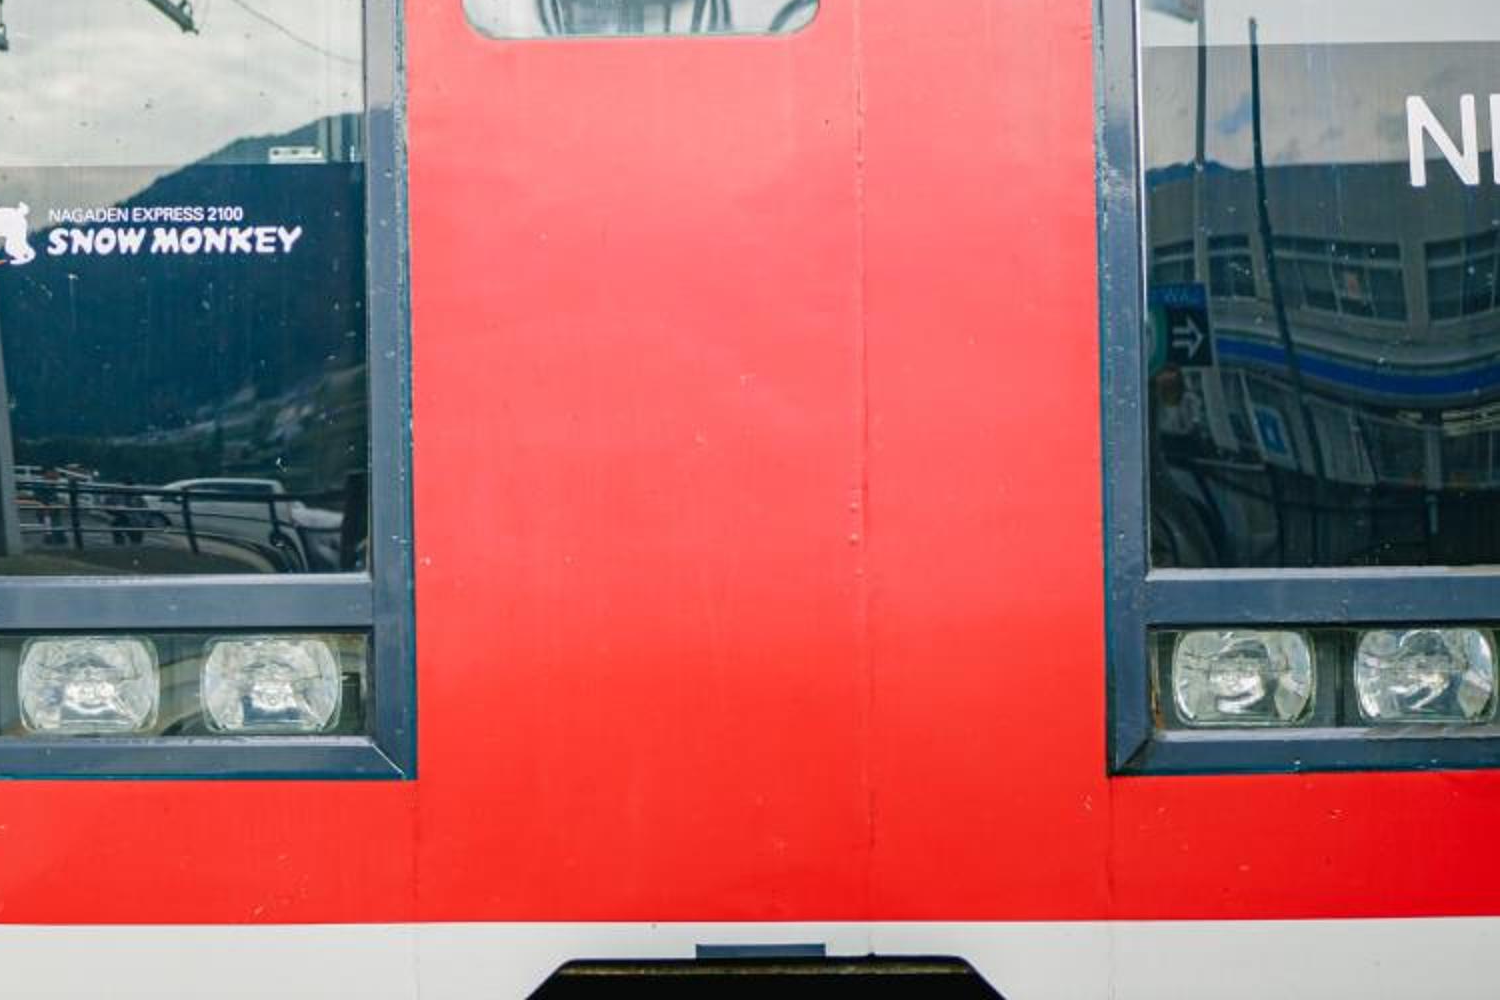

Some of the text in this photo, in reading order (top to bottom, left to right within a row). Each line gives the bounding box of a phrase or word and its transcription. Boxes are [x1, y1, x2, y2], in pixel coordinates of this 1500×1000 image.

[48, 206, 244, 222] NAGADEN EXPRESS 2100
[47, 225, 303, 255] SNOW MONKEY
